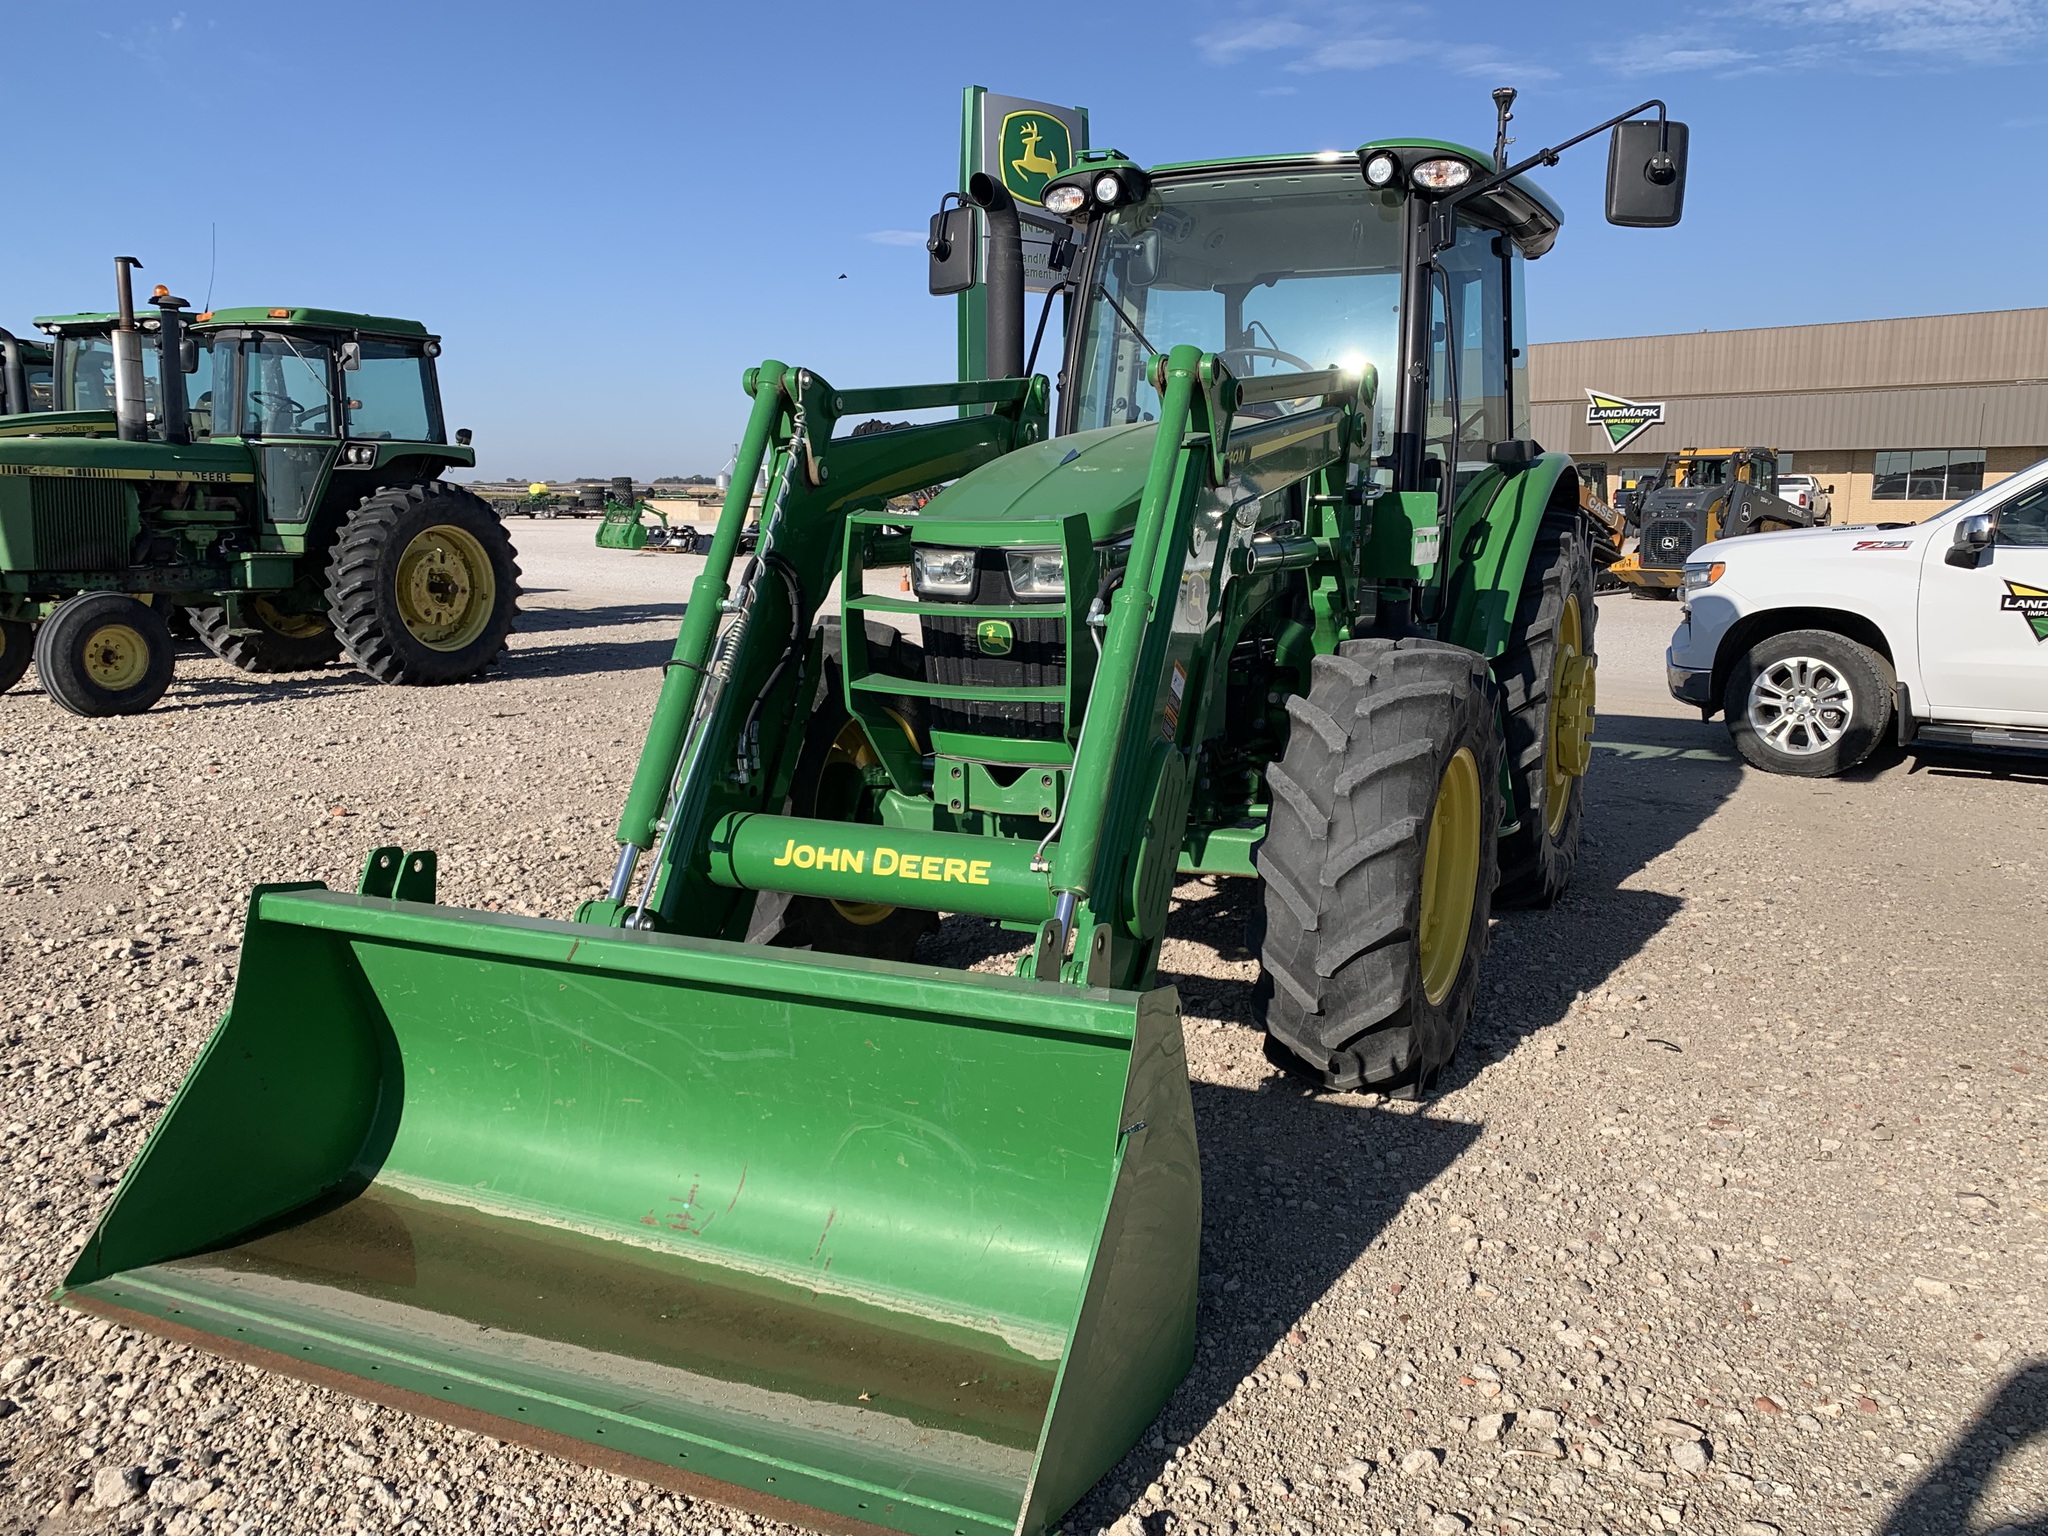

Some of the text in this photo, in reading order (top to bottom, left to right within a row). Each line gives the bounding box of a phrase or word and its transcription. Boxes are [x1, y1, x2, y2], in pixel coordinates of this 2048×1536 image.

[1590, 408, 1659, 418] LANDMARK
[1588, 497, 1614, 521] CASE
[1788, 505, 1803, 517] DEERE
[1852, 541, 1914, 551] Z71
[2003, 598, 2048, 609] LAND
[774, 839, 992, 886] JOHN DEERE
